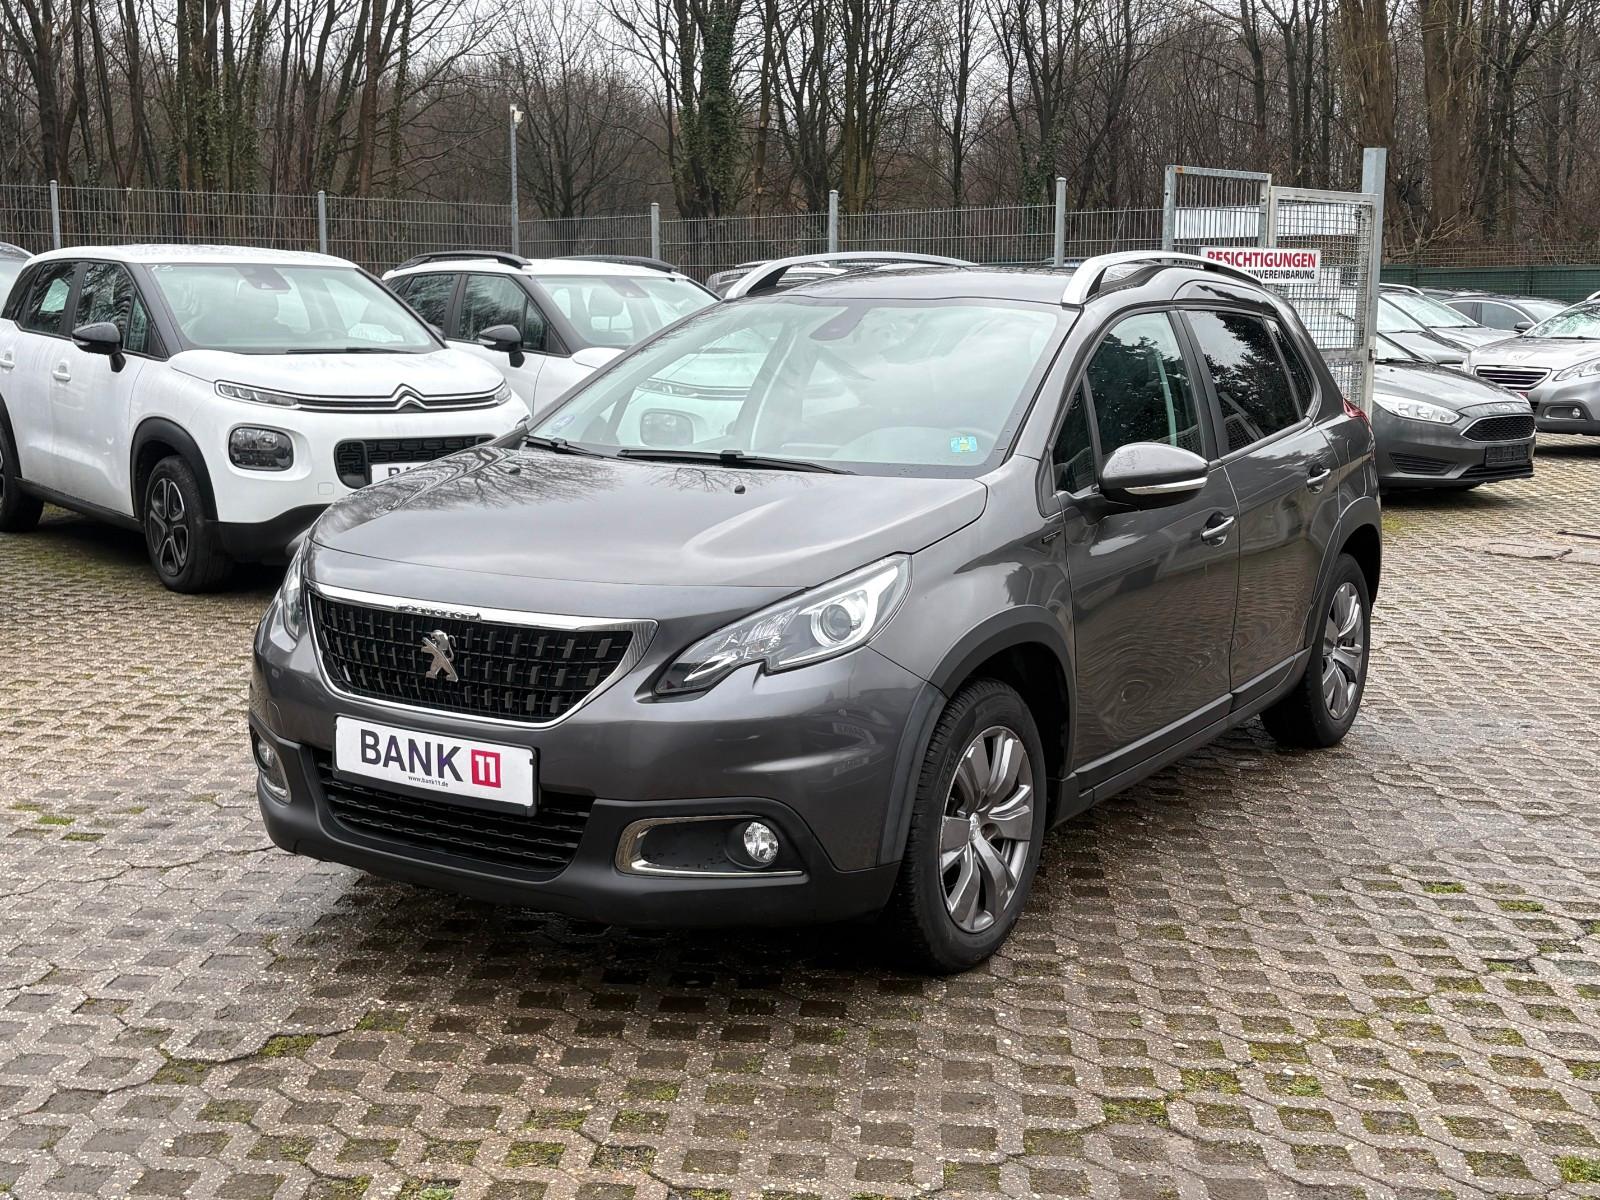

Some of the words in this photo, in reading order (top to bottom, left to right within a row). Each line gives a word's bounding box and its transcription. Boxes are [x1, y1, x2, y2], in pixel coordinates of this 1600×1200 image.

[360, 728, 464, 782] BANK
[475, 755, 496, 783] 11
[408, 775, 449, 788] www.bank11.de
